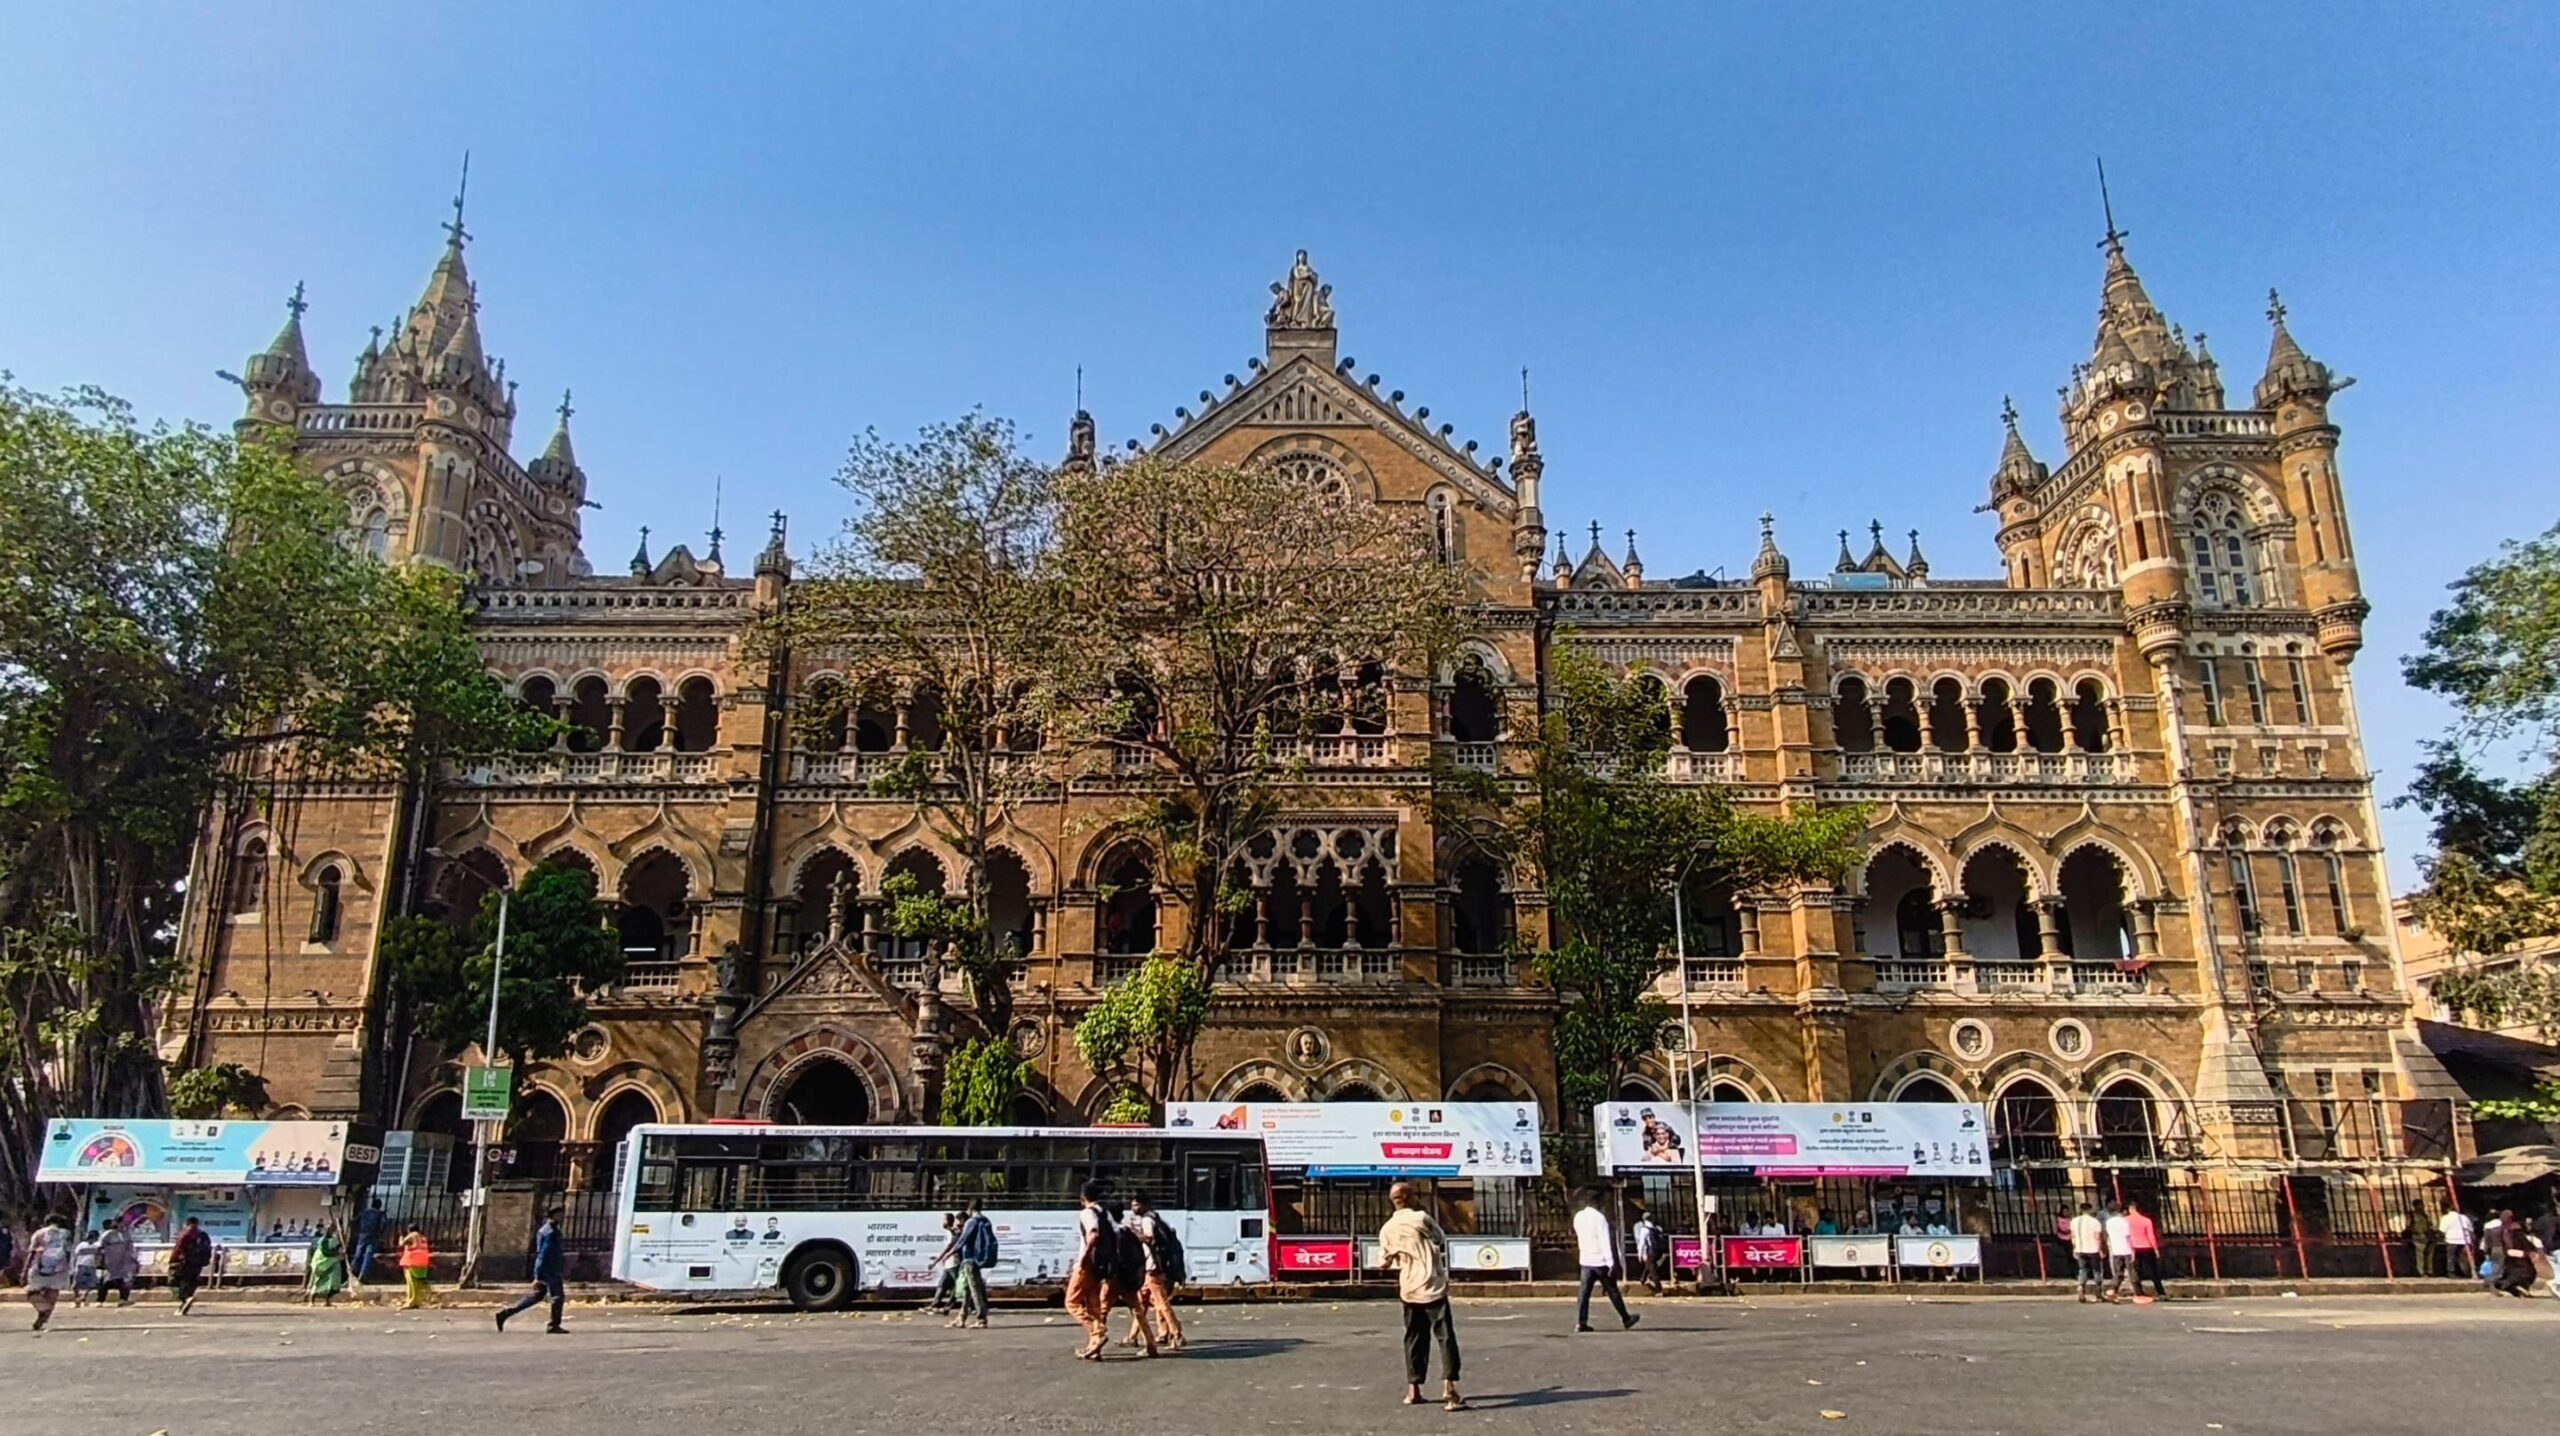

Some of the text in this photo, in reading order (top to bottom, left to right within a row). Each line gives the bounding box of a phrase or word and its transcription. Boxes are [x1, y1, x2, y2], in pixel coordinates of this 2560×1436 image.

[349, 1147, 376, 1161] BEST
[1293, 1248, 1337, 1265] बेस्ट
[1744, 1246, 1787, 1262] बेस्ट
[895, 1266, 936, 1283] बेस्ट
